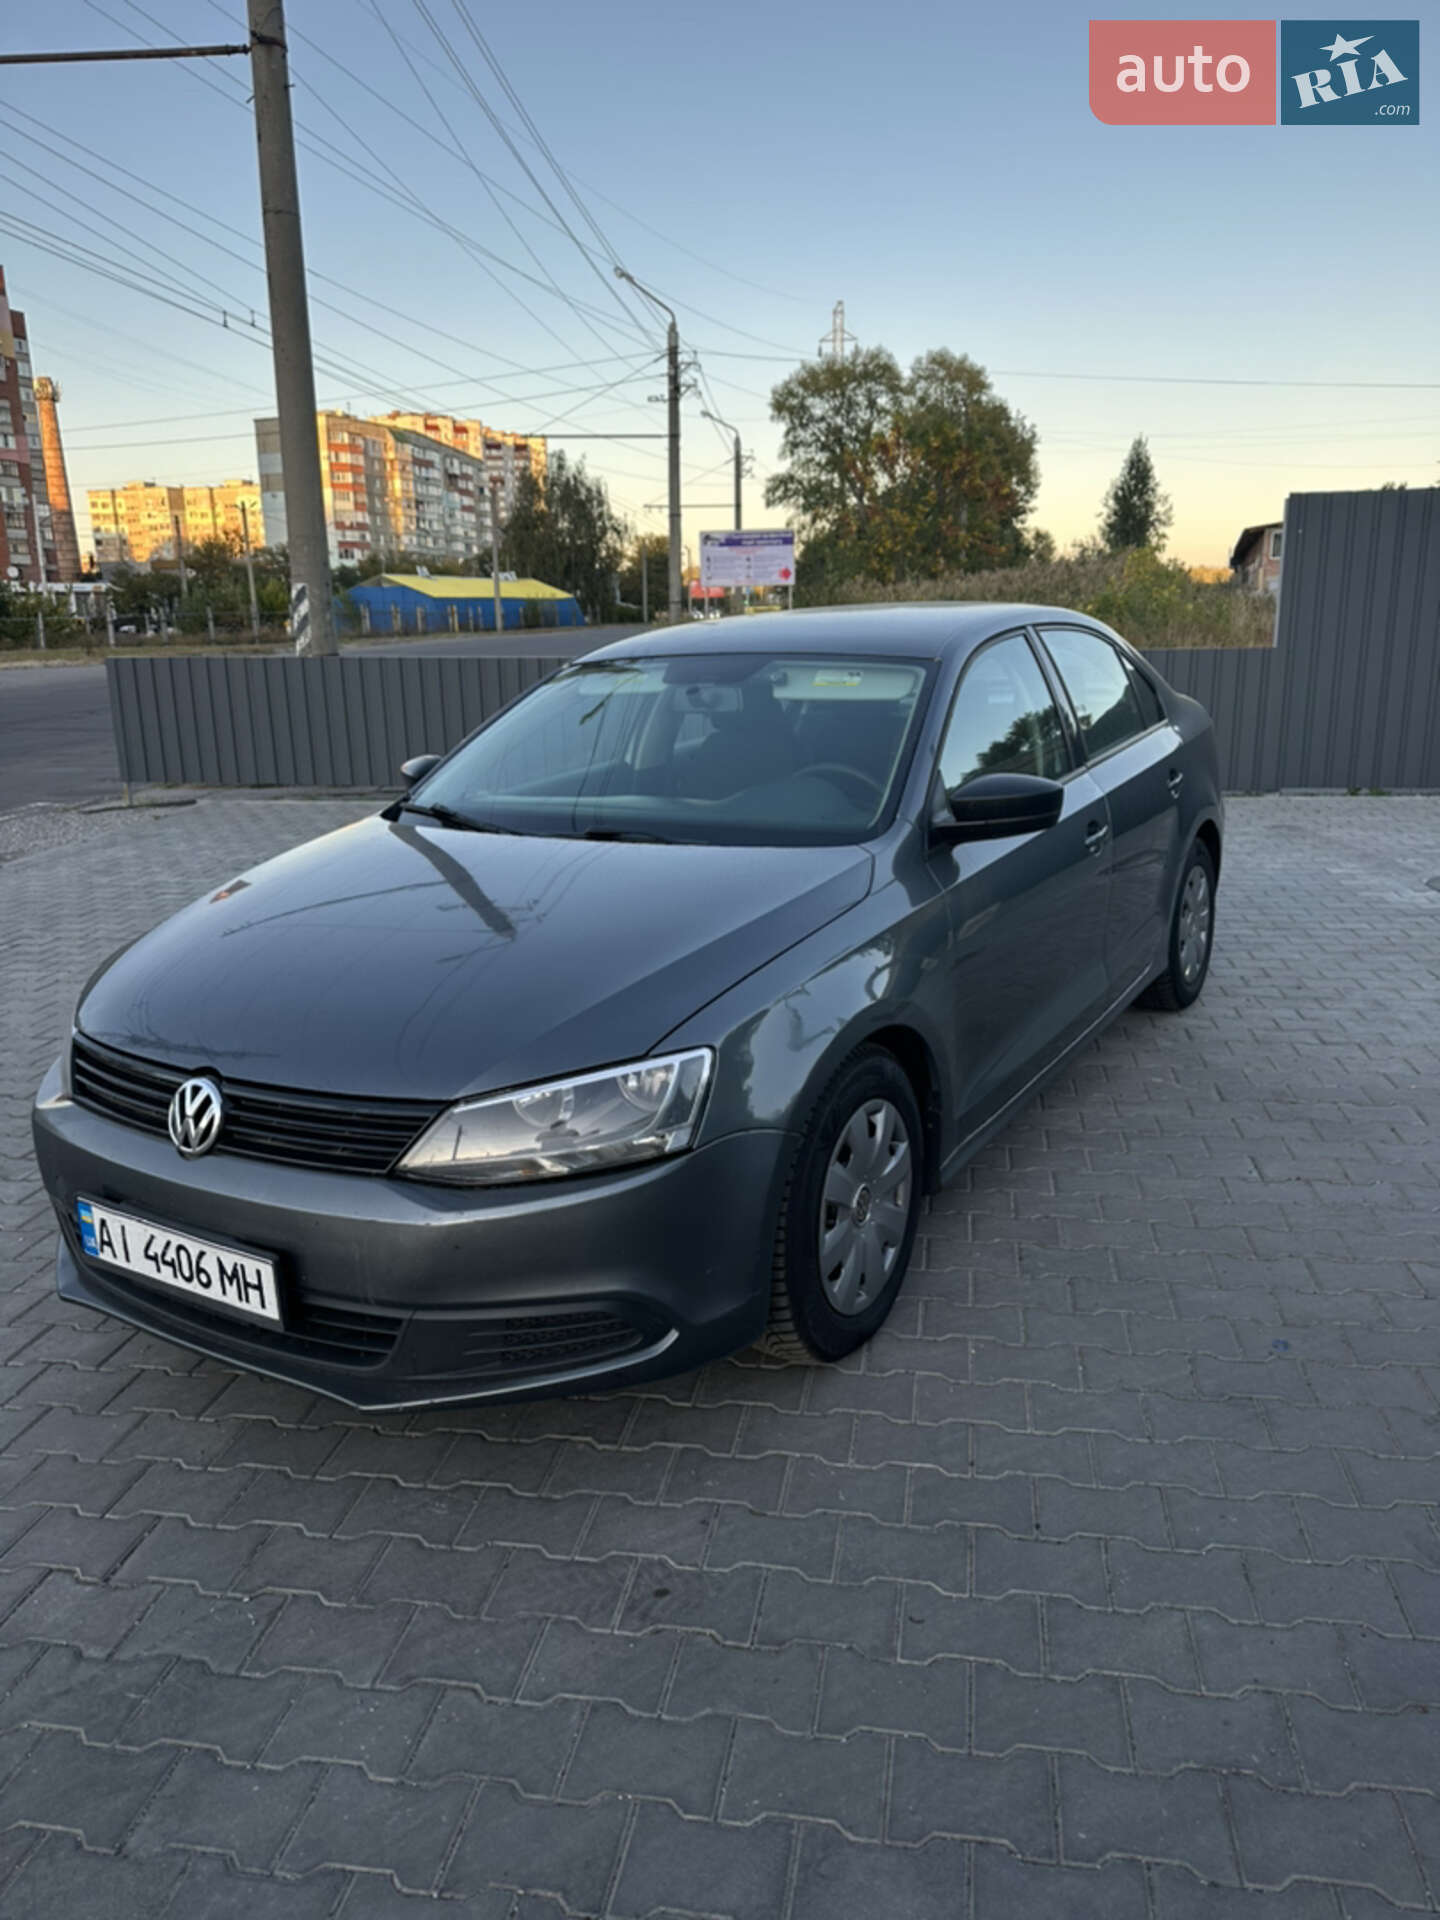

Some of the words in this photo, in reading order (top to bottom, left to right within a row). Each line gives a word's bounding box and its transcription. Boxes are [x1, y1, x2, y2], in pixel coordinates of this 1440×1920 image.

[99, 1217, 131, 1263] AI
[143, 1233, 212, 1290] 4406
[216, 1255, 266, 1309] MH
